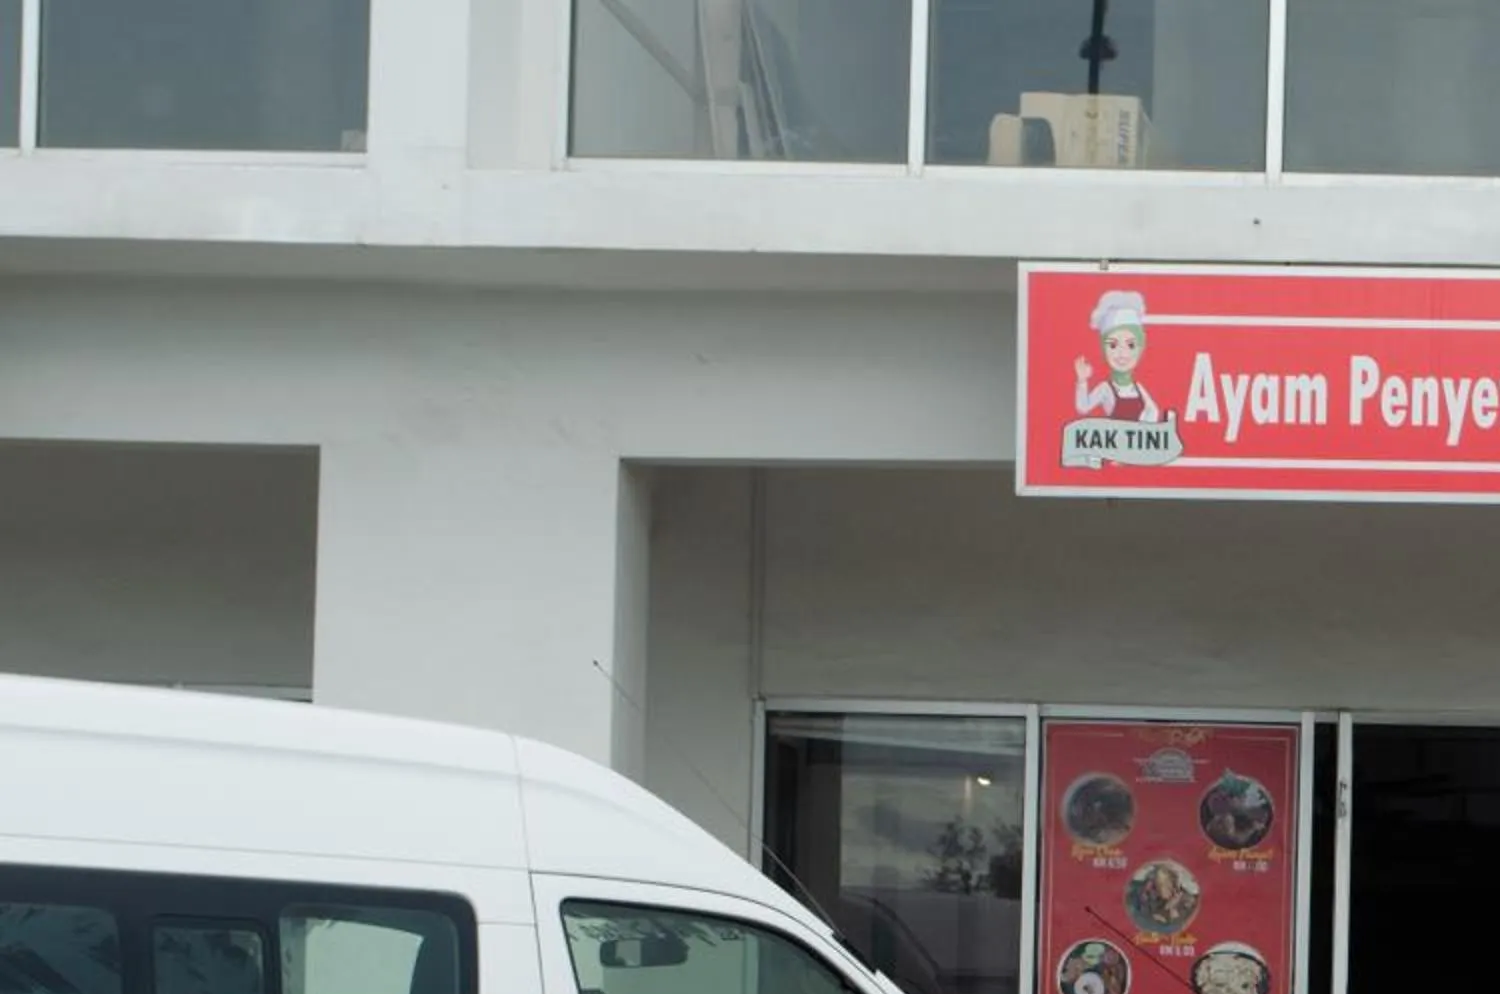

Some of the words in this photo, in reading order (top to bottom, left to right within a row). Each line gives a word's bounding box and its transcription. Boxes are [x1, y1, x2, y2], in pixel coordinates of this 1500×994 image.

[1185, 352, 1327, 443] Ayam
[1075, 428, 1118, 450] KAK
[1125, 429, 1170, 451] TINI
